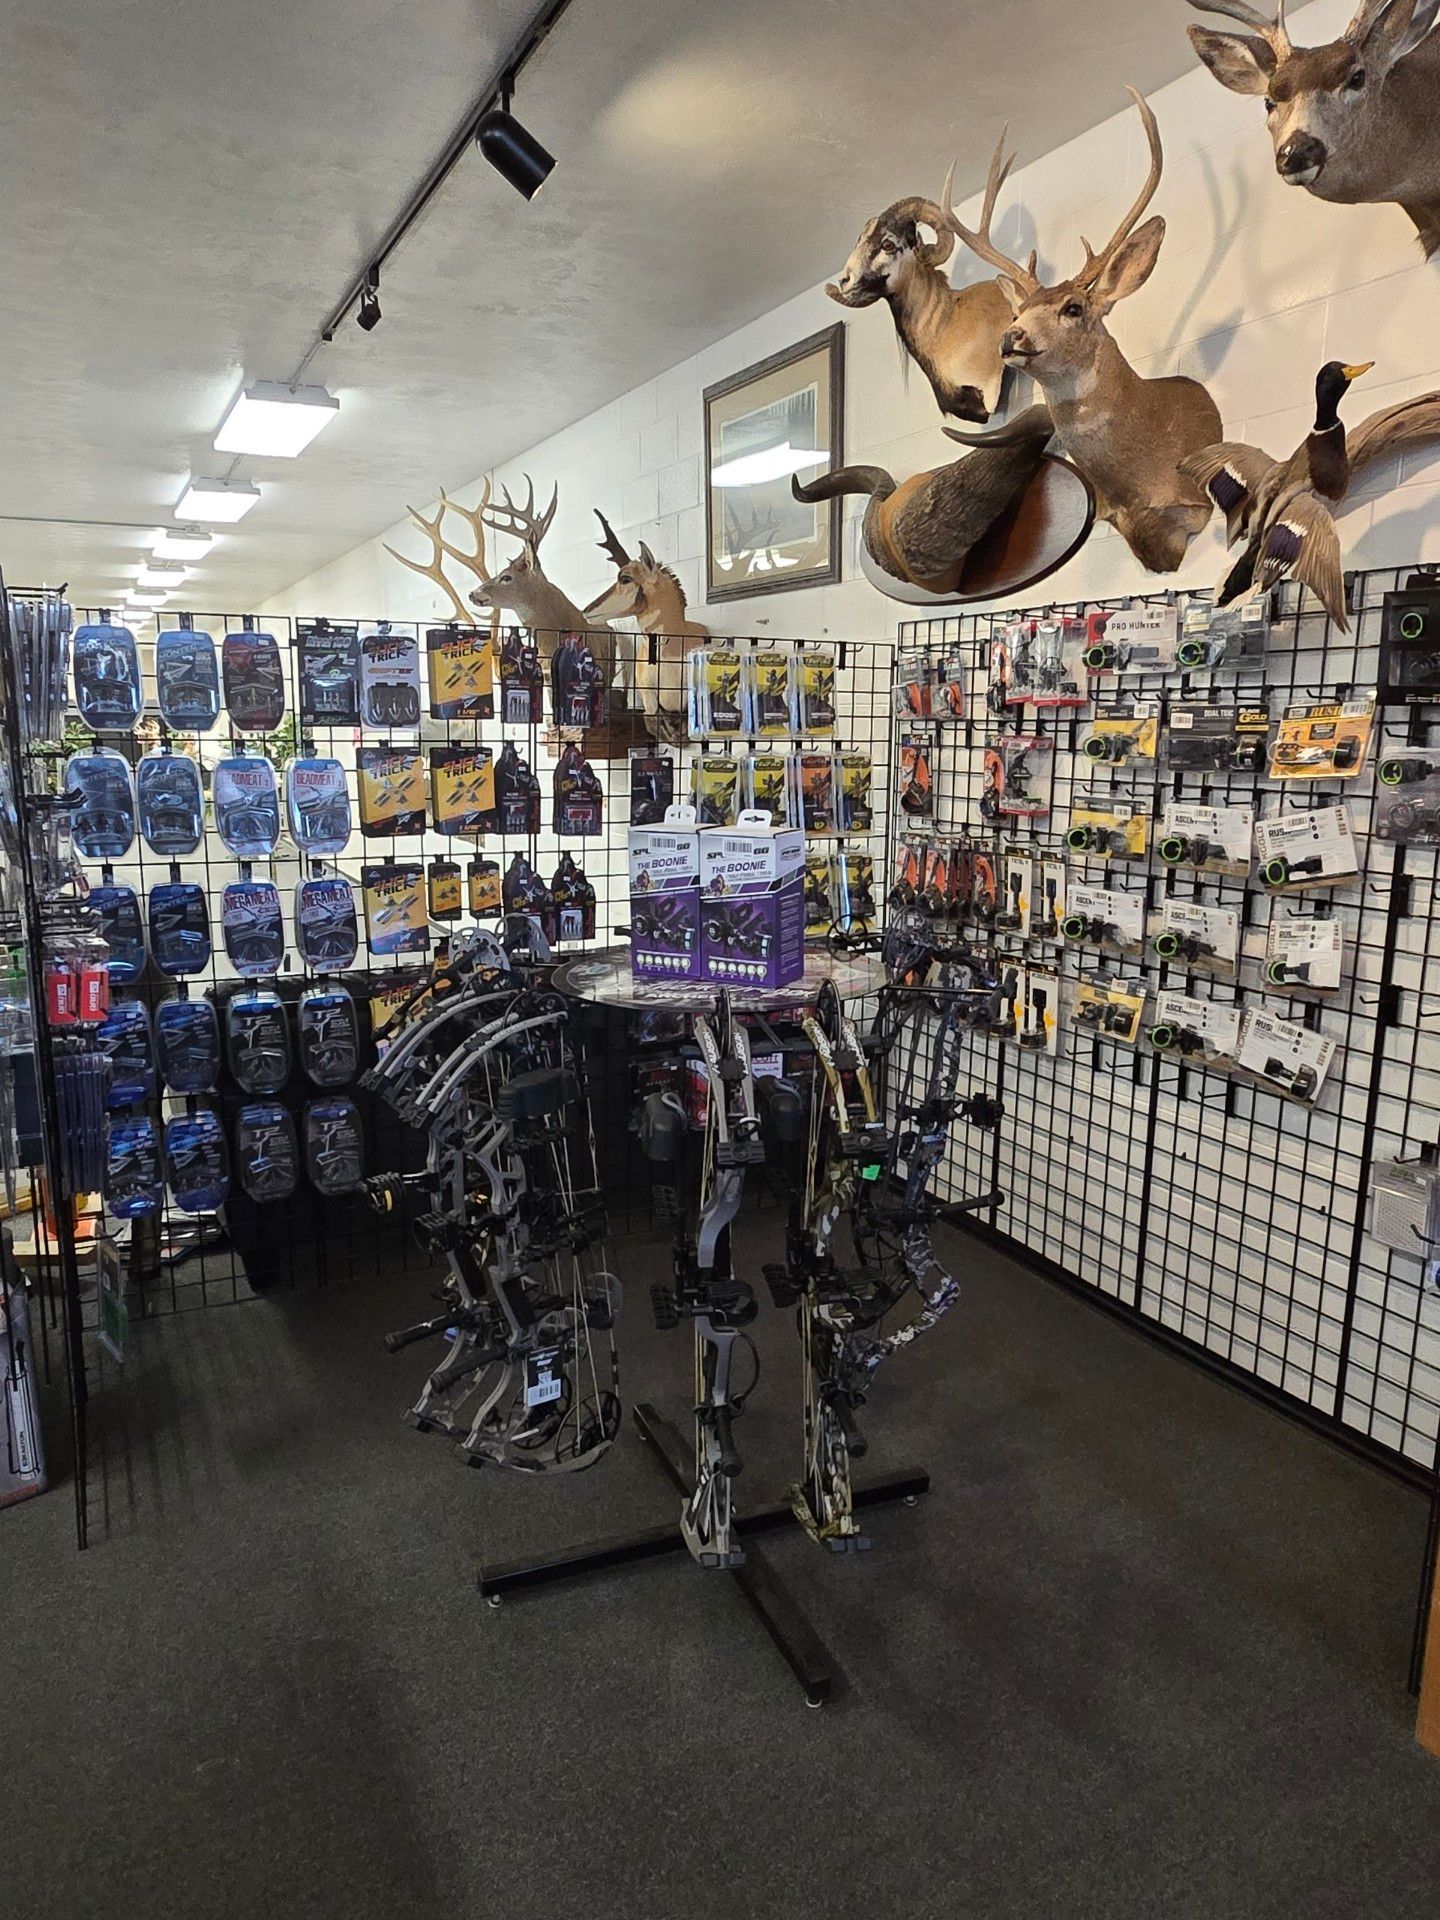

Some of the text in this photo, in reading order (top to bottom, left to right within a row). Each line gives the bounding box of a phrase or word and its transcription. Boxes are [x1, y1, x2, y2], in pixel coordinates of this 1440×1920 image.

[1111, 622, 1126, 630] PRO
[368, 646, 412, 664] TRICK
[441, 645, 485, 659] TRICK
[1239, 714, 1267, 723] GOLD
[369, 763, 415, 779] TRICK
[443, 763, 487, 778] TRICK
[296, 772, 335, 786] DEADMEAT
[651, 856, 688, 868] BOONIE
[711, 860, 767, 874] THE BOONIE
[373, 882, 417, 897] TRICK
[224, 889, 279, 911] MEGAMEAT
[301, 886, 353, 910] MEGAMEAT
[243, 1015, 275, 1026] T2
[314, 1008, 344, 1019] T2
